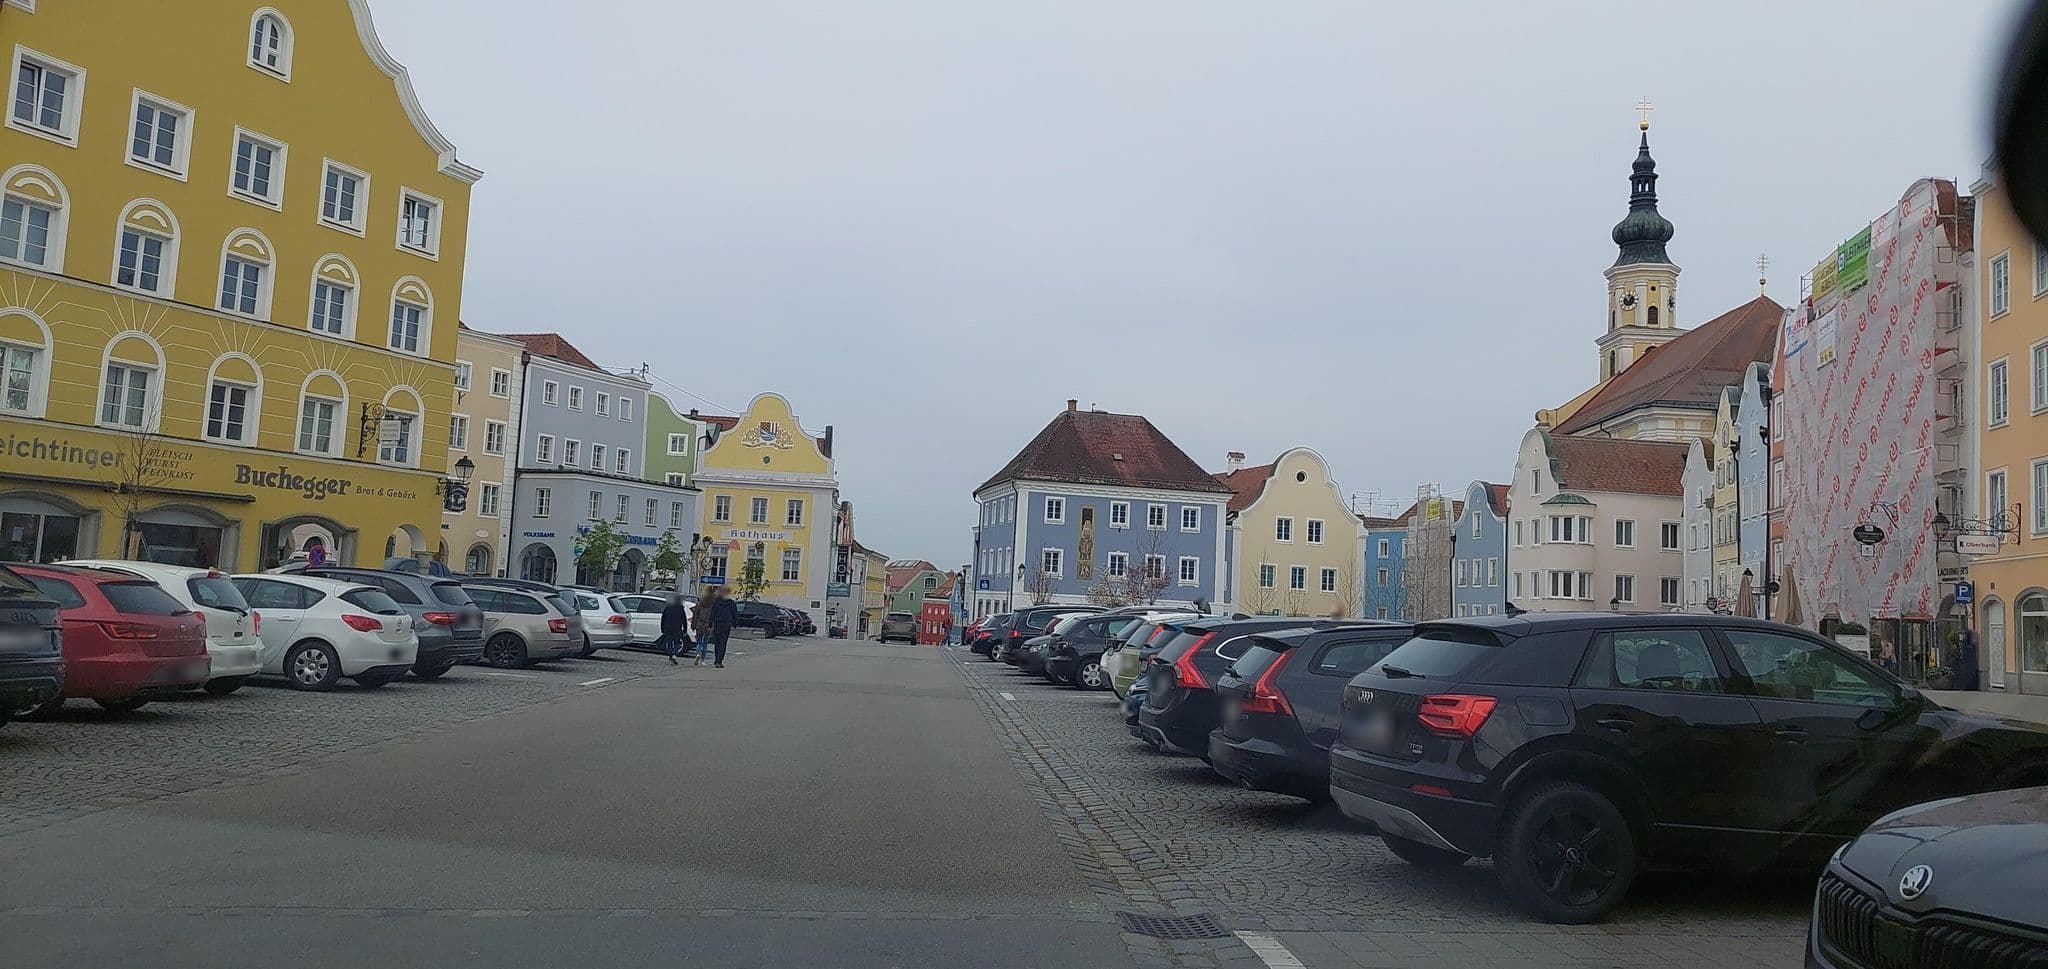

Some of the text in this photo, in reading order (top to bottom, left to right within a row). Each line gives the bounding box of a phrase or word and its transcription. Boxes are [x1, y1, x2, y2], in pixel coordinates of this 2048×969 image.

[1847, 377, 1867, 429] RINGER
[1877, 372, 1896, 425] RINGER
[146, 457, 181, 469] WURST
[234, 464, 351, 500] Buchegger
[356, 485, 375, 495] Brot
[387, 487, 417, 500] Gebäck
[730, 529, 784, 540] Rathaus
[1959, 585, 1968, 597] P
